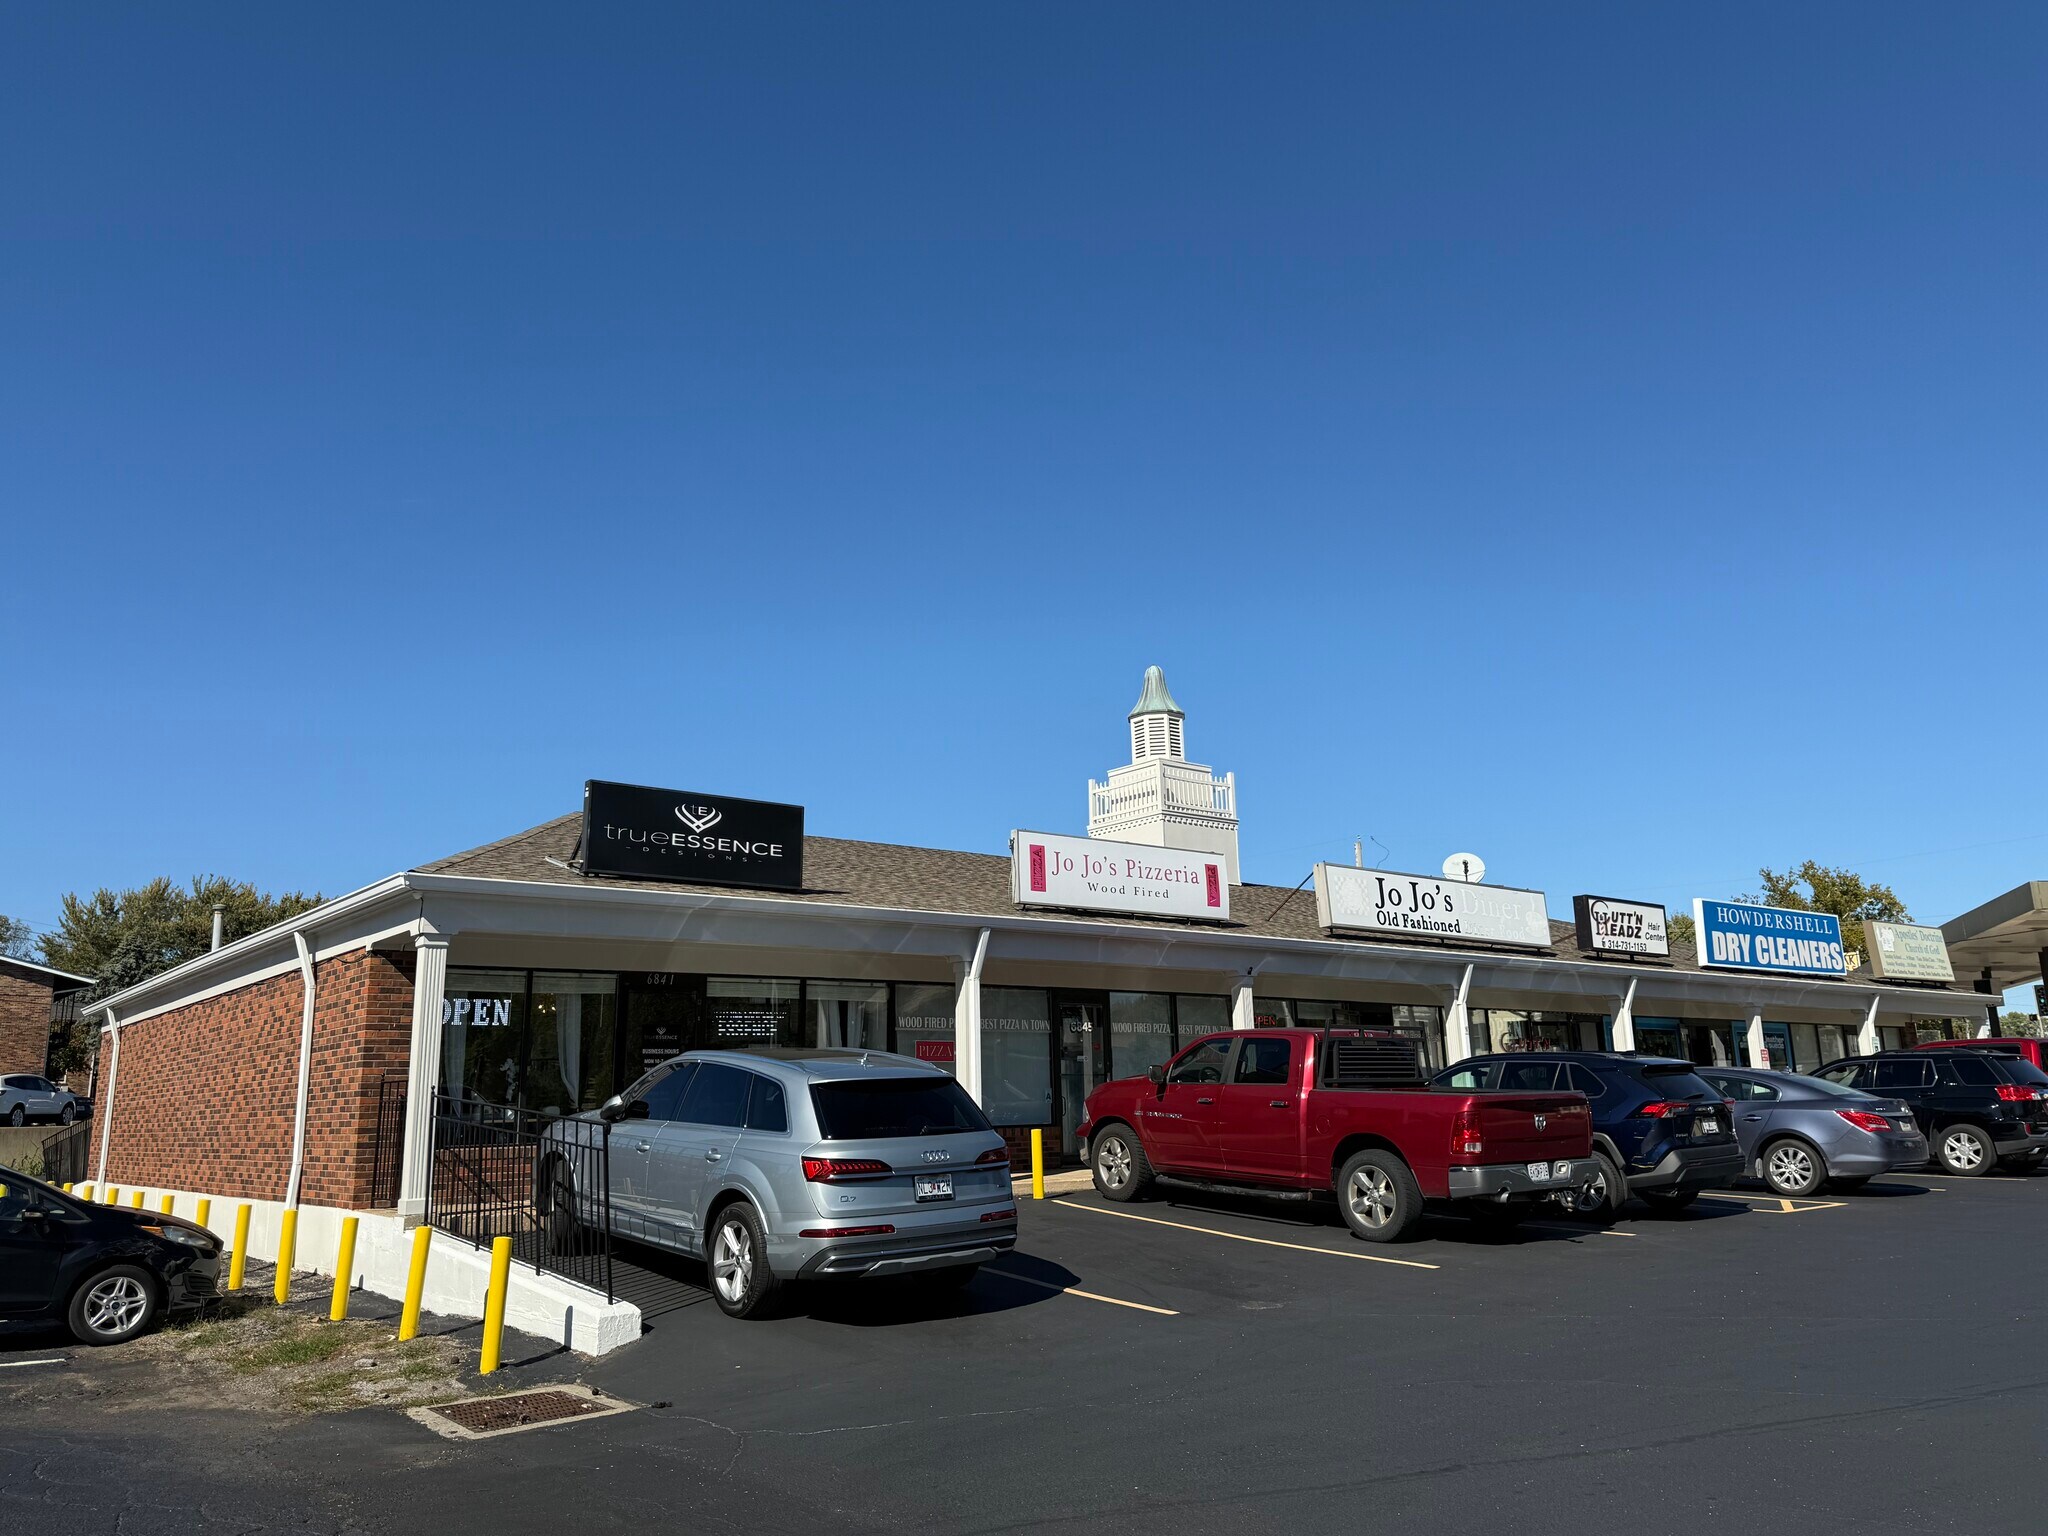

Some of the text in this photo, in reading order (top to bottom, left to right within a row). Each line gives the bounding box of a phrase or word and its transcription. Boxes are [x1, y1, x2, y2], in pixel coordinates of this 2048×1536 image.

[604, 823, 783, 857] trueESSENCE
[642, 846, 748, 863] DESIGNS
[1033, 847, 1043, 889] PIZZA
[1052, 851, 1200, 885] Jo Jo's Pizzeria
[1087, 882, 1170, 899] Wood Fired
[1207, 866, 1218, 905] PIZZA
[1376, 910, 1400, 928] Old
[1402, 914, 1461, 934] Fashioned
[1647, 922, 1661, 931] Hair
[1716, 907, 1833, 935] HOWDERSHELL
[1645, 932, 1666, 942] Center
[1607, 940, 1647, 952] 314-731-1153
[1711, 930, 1843, 971] DRY CLEANERS
[647, 973, 675, 985] 6841
[898, 1016, 922, 1029] WOOD
[924, 1016, 947, 1029] FIRED
[980, 1018, 1050, 1031] BEST PIZZA IN TOWN
[1070, 1021, 1093, 1032] 6845
[1112, 1022, 1171, 1034] WOOD FIRED PIZZA
[1179, 1024, 1193, 1034] BEST
[1195, 1024, 1211, 1034] PIZZA
[918, 1045, 952, 1057] PIZZA
[840, 1195, 857, 1203] Q7
